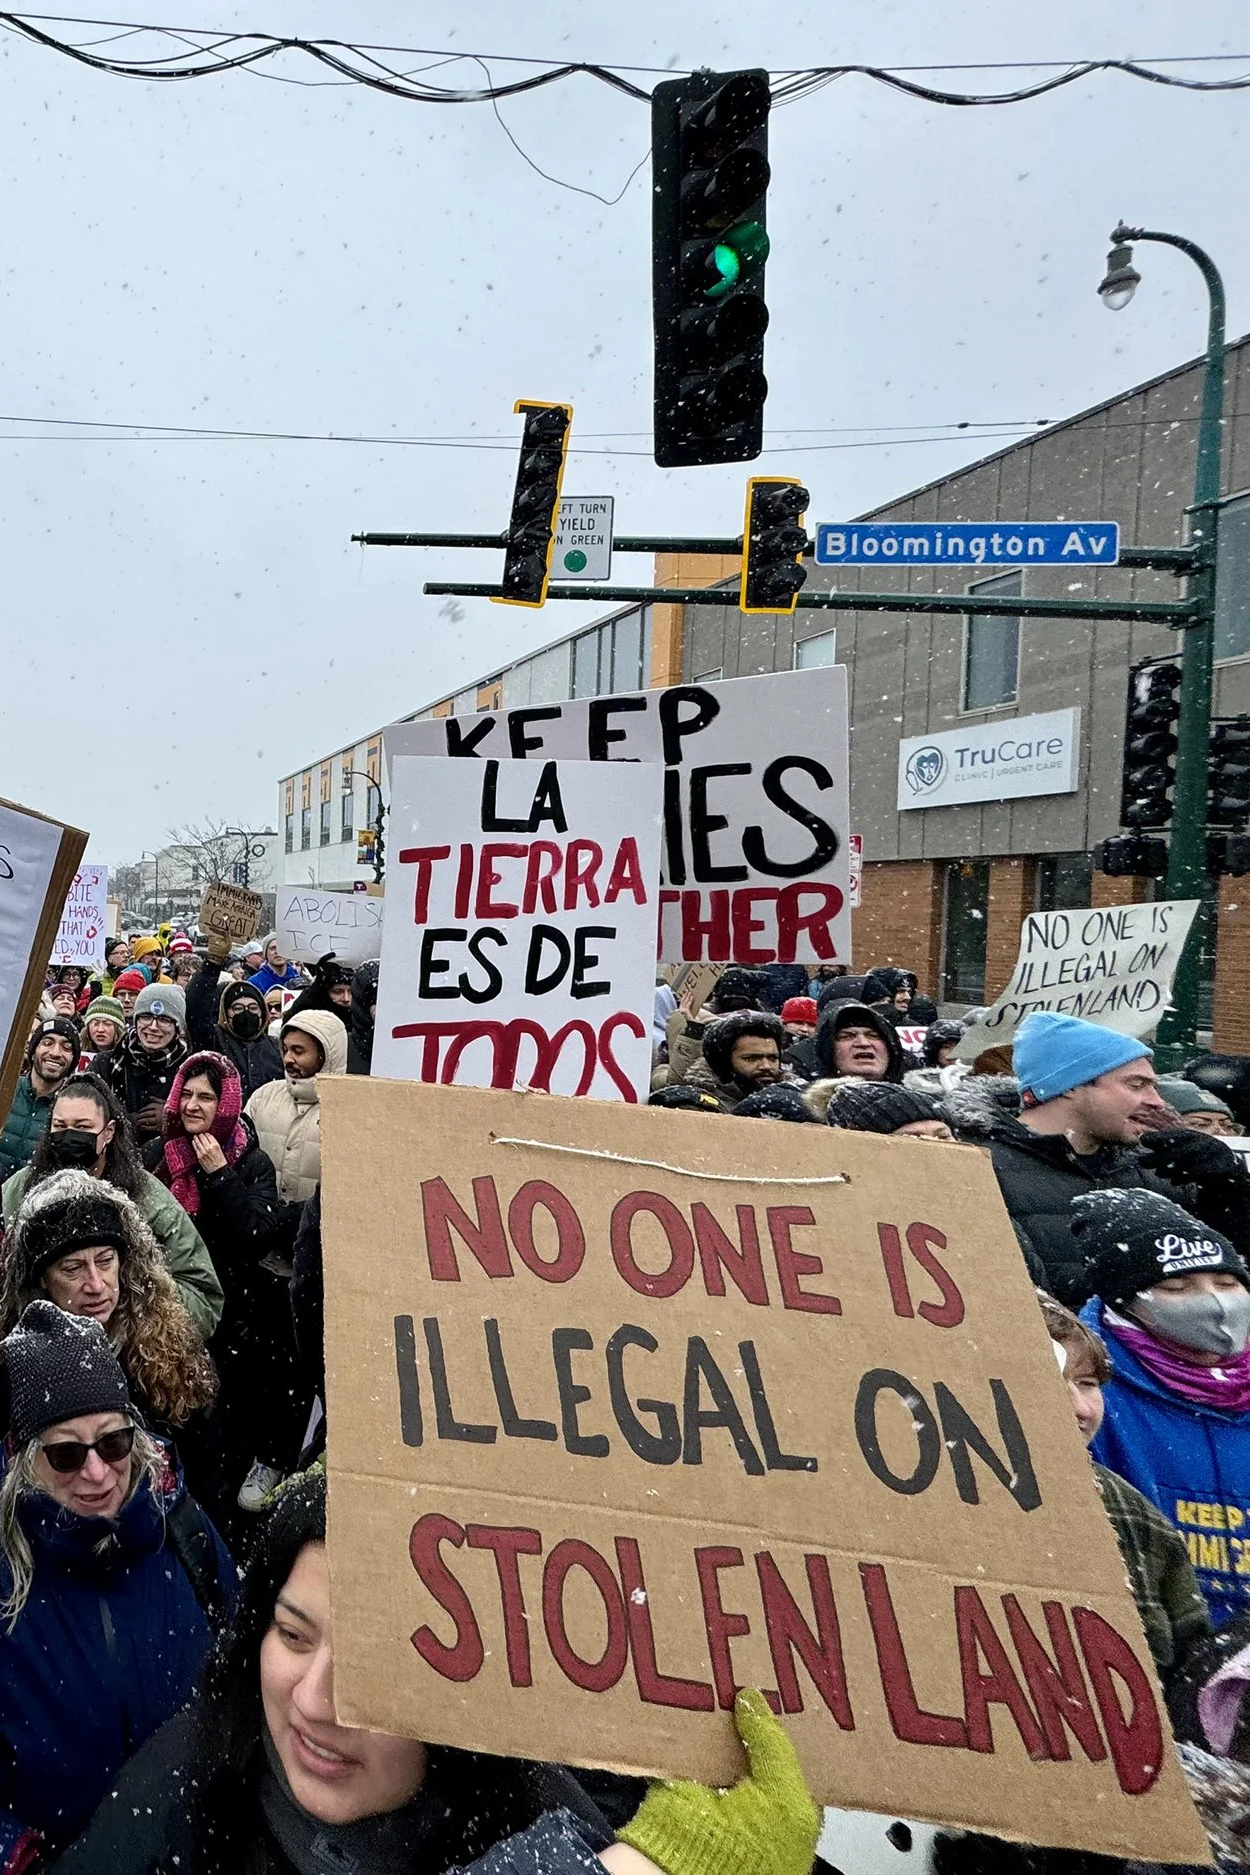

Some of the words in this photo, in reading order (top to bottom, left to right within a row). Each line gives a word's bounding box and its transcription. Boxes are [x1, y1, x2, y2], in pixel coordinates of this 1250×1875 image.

[560, 518, 596, 531] YIELD
[580, 504, 607, 514] TURN
[553, 535, 563, 545] N
[571, 535, 605, 546] GREEN
[825, 531, 1046, 564] Bloomington
[1061, 531, 1108, 556] Av
[954, 738, 1064, 768] TruCare
[954, 771, 990, 783] CLINIC
[996, 764, 1035, 777] URGENT
[1036, 760, 1064, 772] CARE
[481, 760, 568, 834] LA
[398, 837, 648, 925] TIERRA
[73, 939, 95, 956] YOU
[1027, 913, 1071, 953] NO
[1081, 908, 1138, 947] ONE
[1151, 905, 1174, 934] IS
[418, 927, 508, 1004] ES
[525, 924, 617, 1000] DE
[1014, 950, 1118, 996] ILLEGAL
[1128, 943, 1169, 974] ON
[392, 1010, 647, 1104] TODOS
[419, 1174, 587, 1285] NO
[610, 1190, 842, 1317] ONE
[877, 1220, 966, 1328] IS
[1154, 1233, 1218, 1263] Live
[394, 1313, 819, 1478] ILLEGAL
[853, 1367, 1044, 1514] ON
[1176, 1499, 1245, 1531] KEEP
[408, 1511, 857, 1734] STOLEN
[857, 1561, 1165, 1796] LAND
